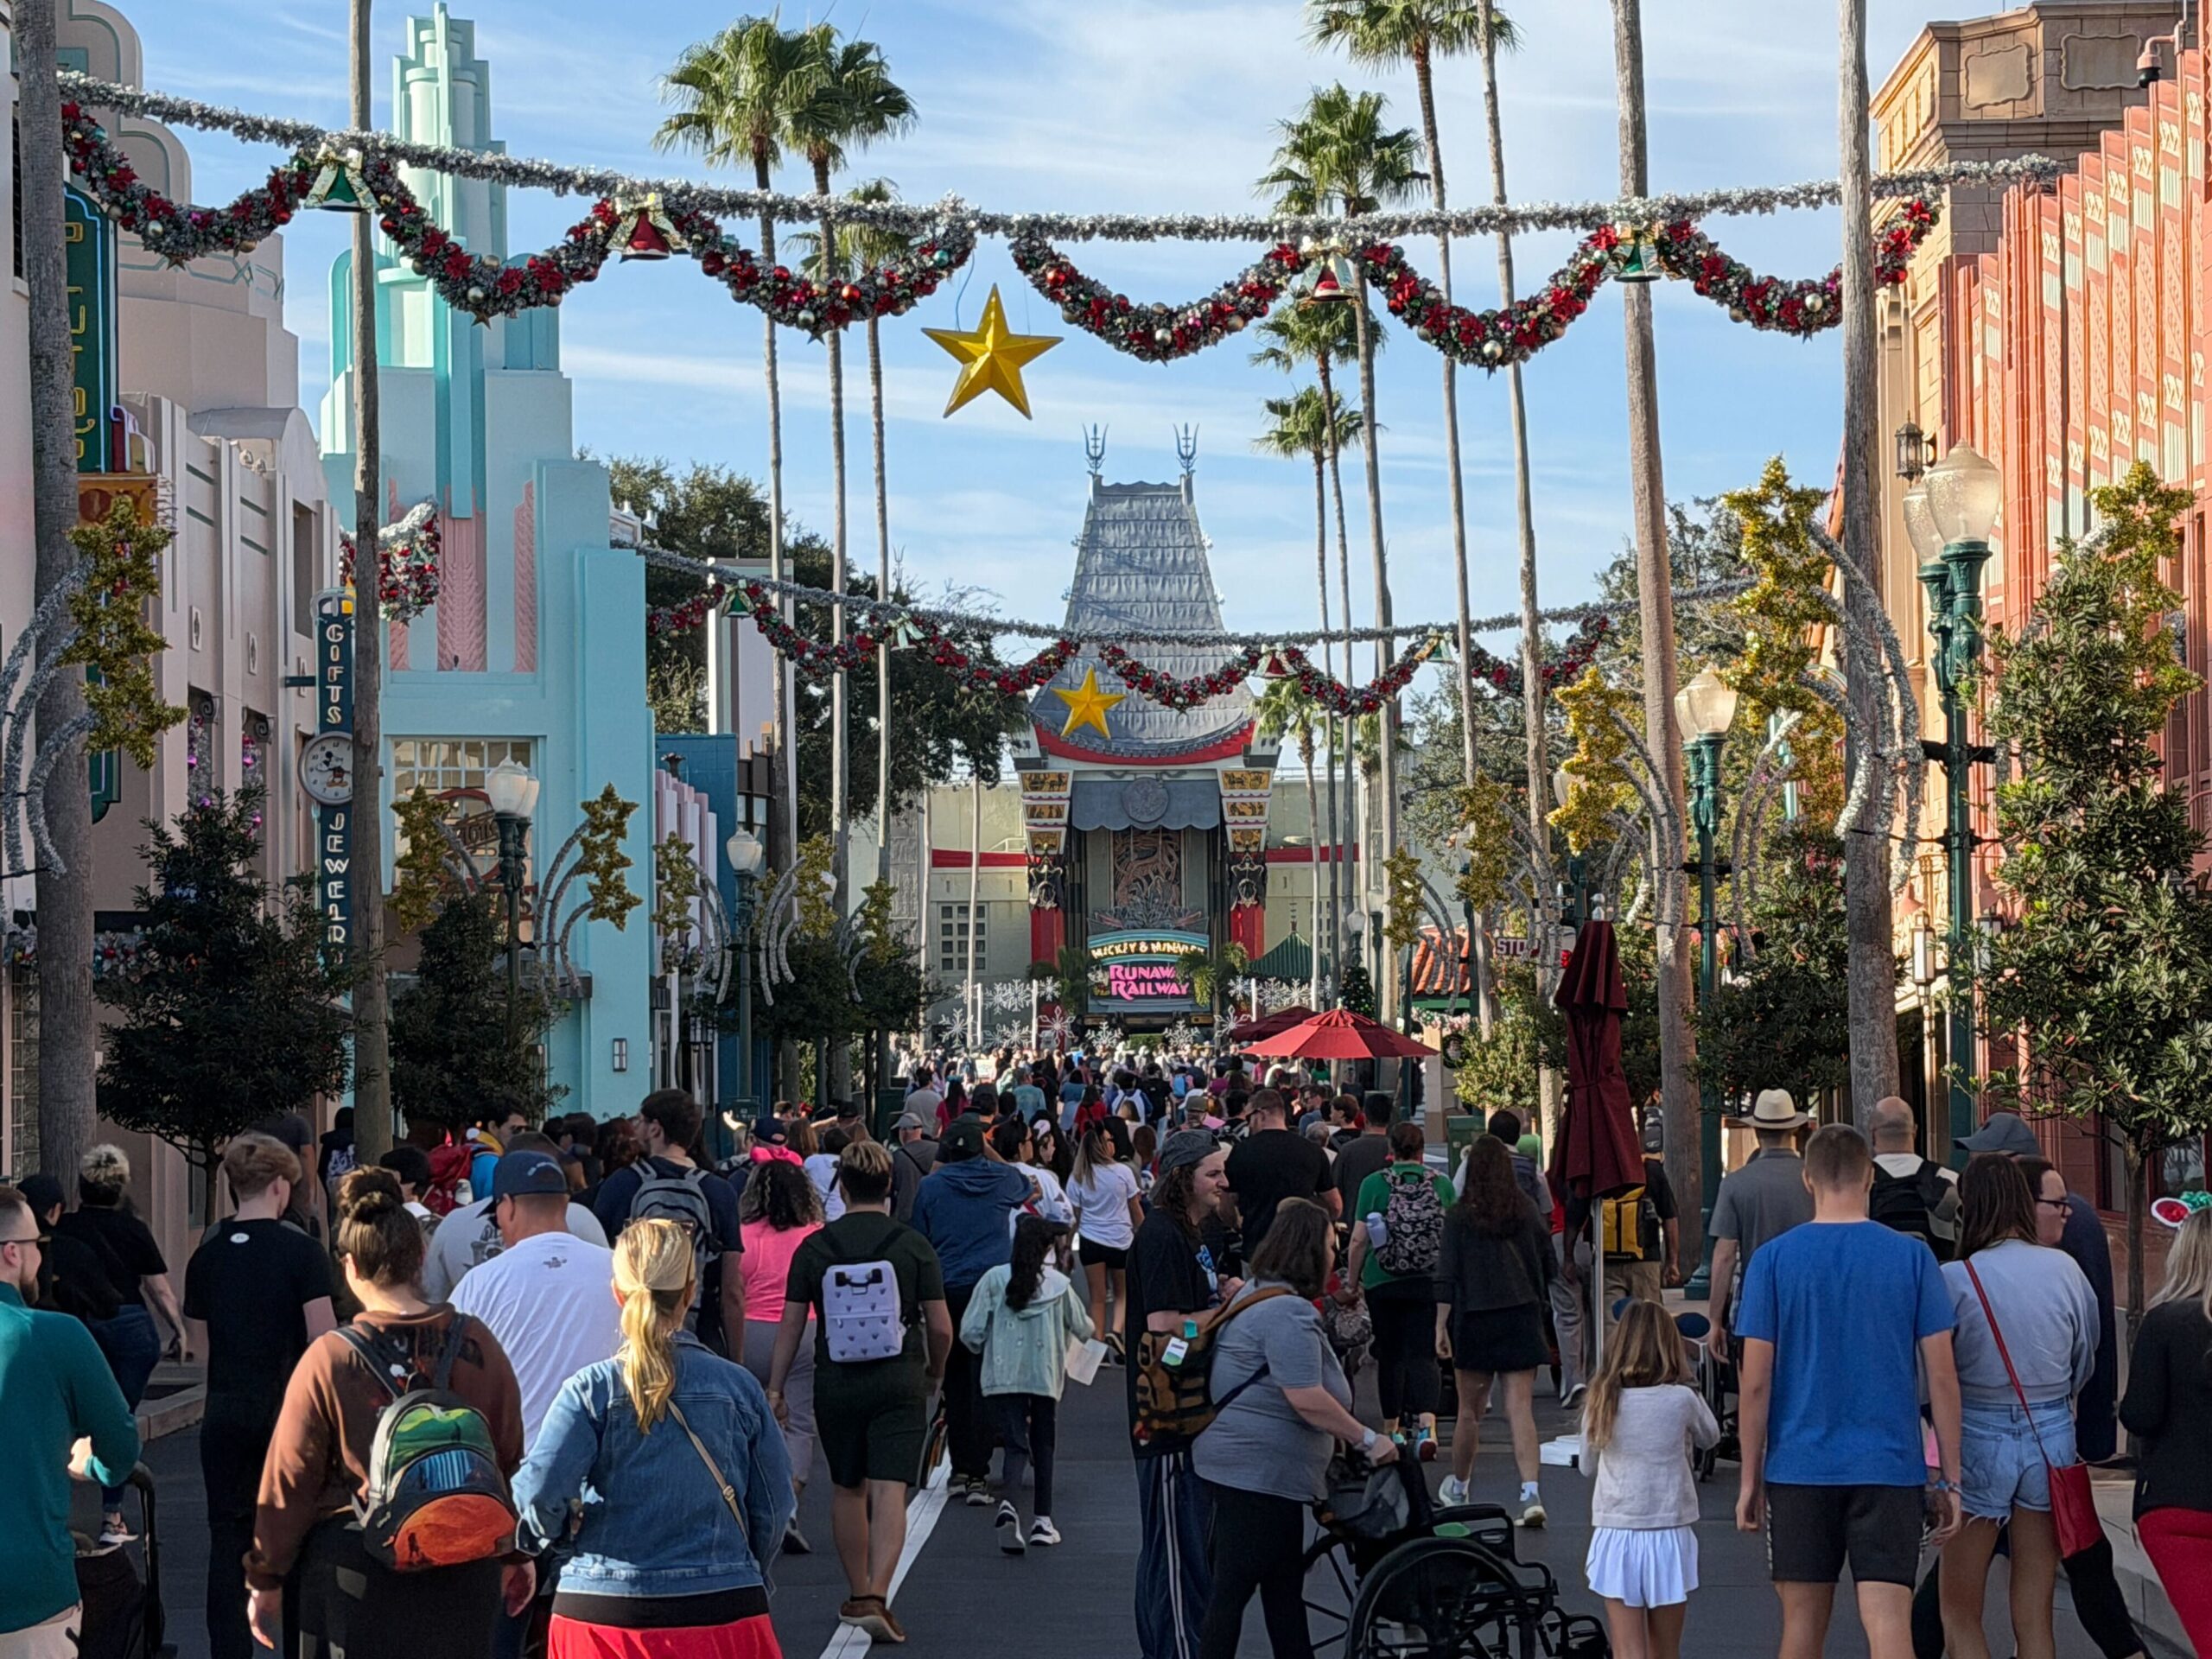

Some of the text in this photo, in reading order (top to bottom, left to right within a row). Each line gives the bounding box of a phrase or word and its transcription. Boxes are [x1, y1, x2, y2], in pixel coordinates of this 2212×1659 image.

[326, 623, 345, 724] GIFTS
[325, 812, 349, 964] JEWELR
[1090, 942, 1138, 959] MICKEY
[1140, 941, 1148, 952] &
[1497, 938, 1539, 956] STO
[1109, 965, 1176, 980] RUNAW
[1111, 981, 1190, 1001] RAILWAY
